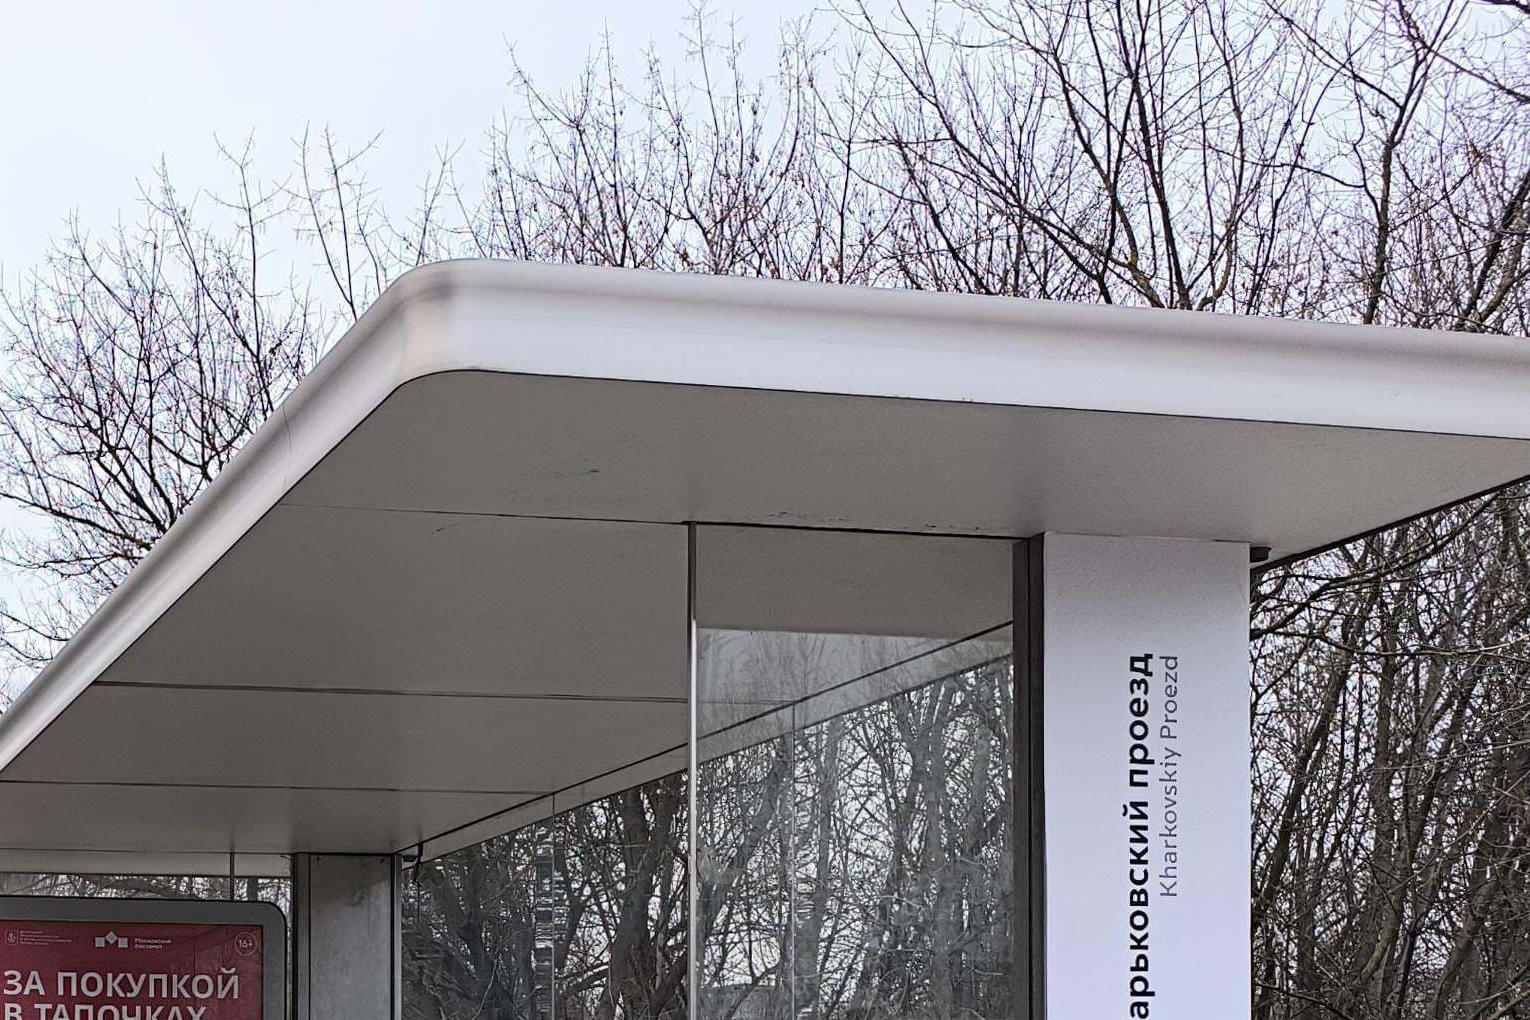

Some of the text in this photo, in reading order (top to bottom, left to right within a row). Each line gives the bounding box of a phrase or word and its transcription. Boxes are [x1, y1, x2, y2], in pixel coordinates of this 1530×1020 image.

[1129, 653, 1155, 788] проезд
[1158, 655, 1182, 897] Kharkovskiy Proezd
[3, 967, 239, 999] ЗА ПОКУПКОЙ
